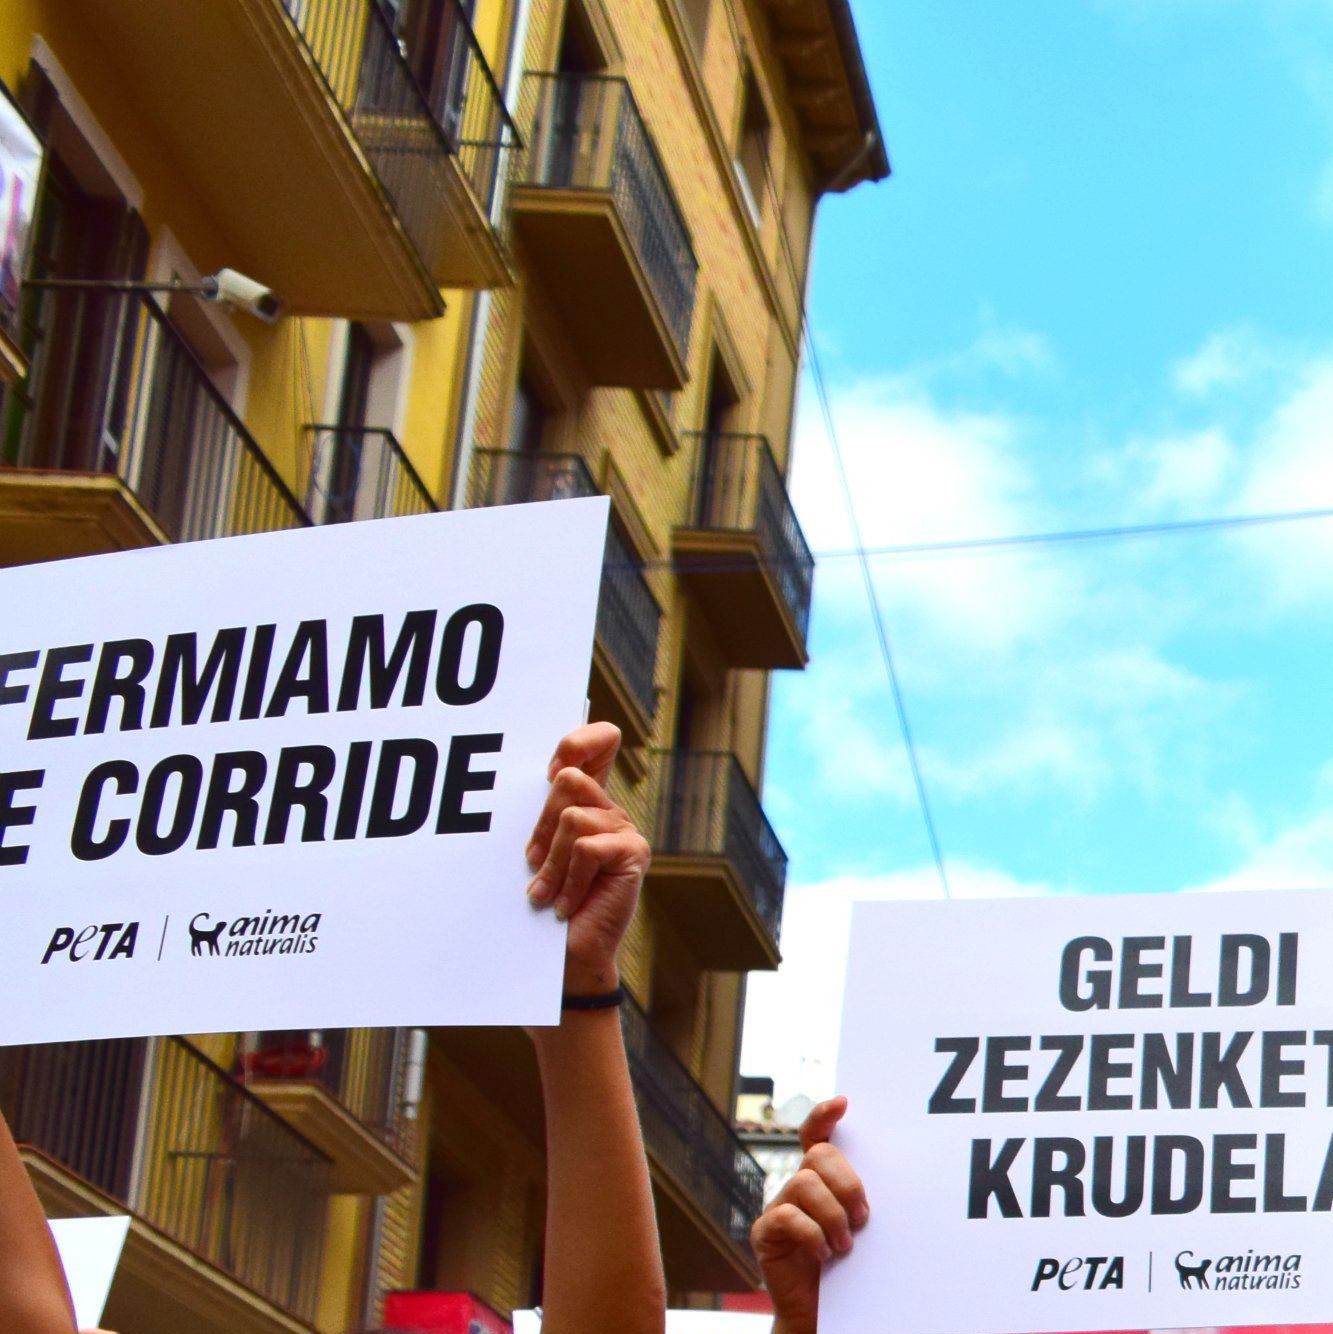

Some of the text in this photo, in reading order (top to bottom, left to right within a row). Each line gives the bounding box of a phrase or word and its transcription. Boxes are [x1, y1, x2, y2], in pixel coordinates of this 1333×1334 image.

[0, 603, 505, 741] FERMIAMO
[70, 733, 504, 862] CORRIDE
[228, 909, 322, 938] anima
[225, 931, 318, 957] naturalis
[1059, 932, 1299, 1012] GELDI
[1215, 1249, 1302, 1273] anima
[1215, 1270, 1301, 1291] naturalis
